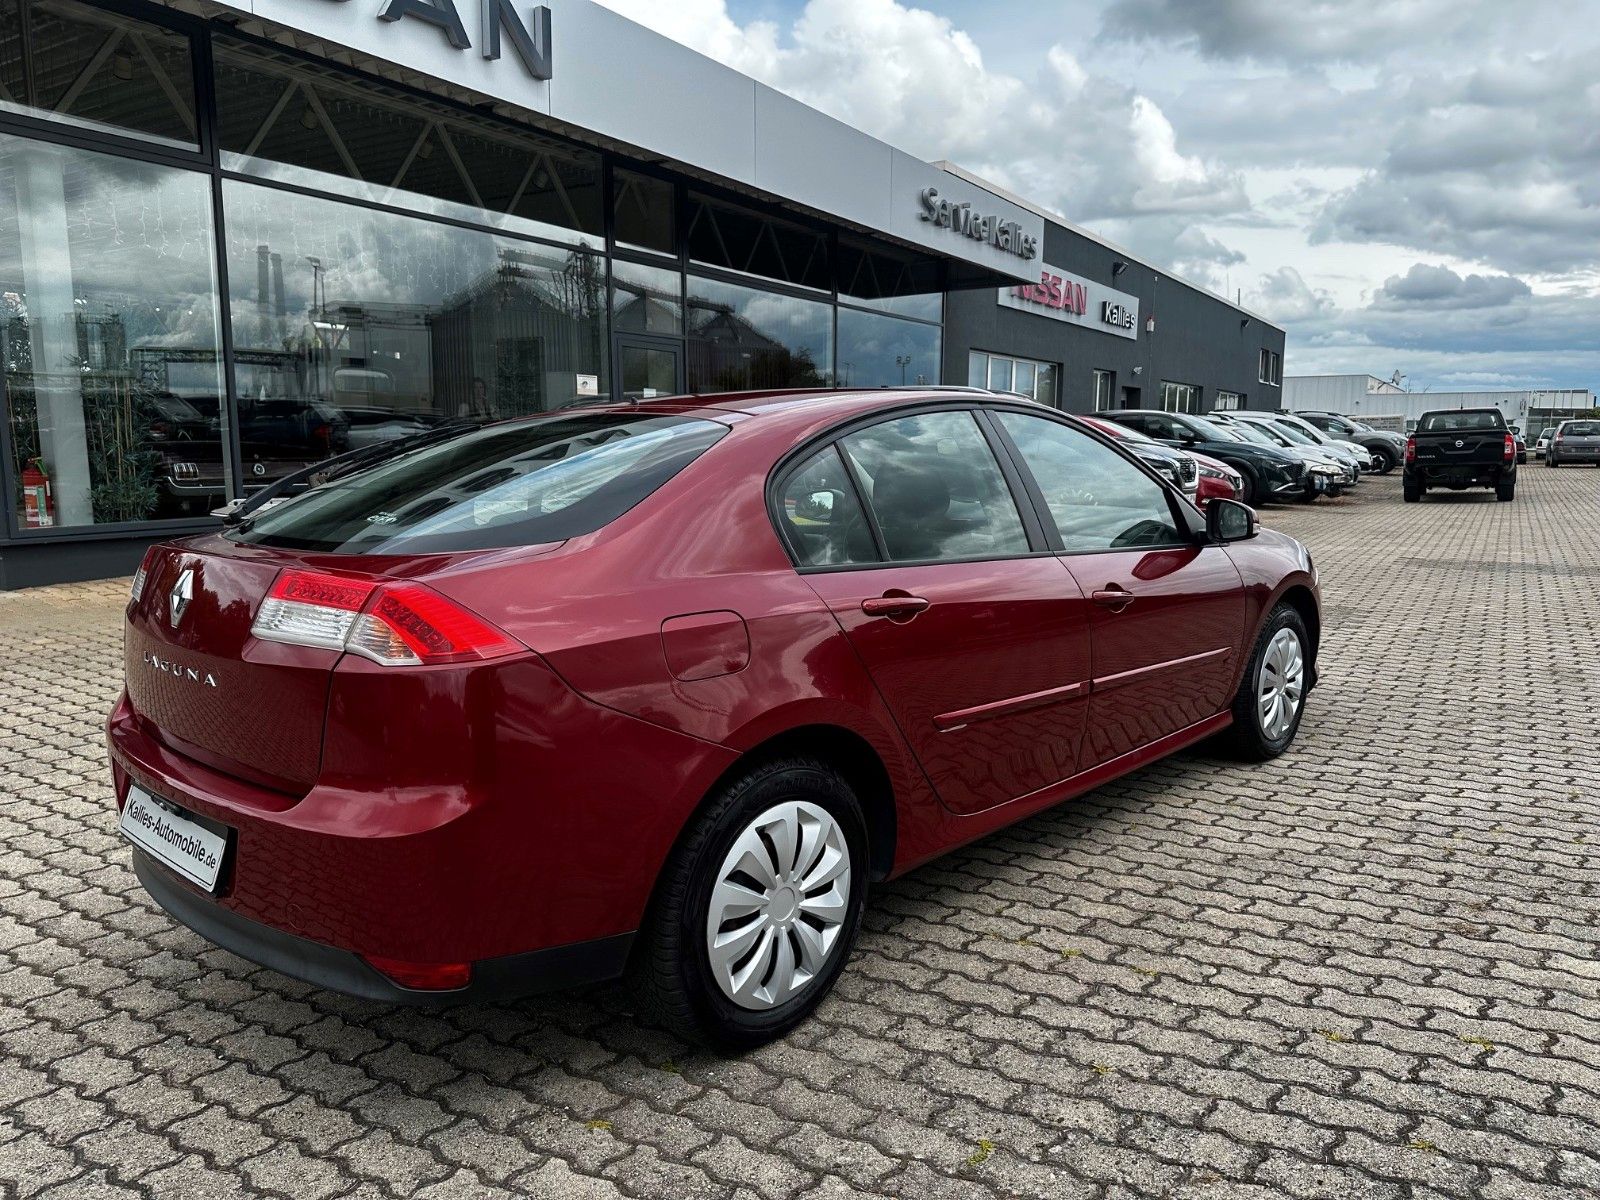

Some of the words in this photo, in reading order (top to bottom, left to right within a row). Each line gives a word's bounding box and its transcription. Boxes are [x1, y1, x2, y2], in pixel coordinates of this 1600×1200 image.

[330, 0, 552, 80] AN
[919, 187, 990, 242] Service
[989, 215, 1038, 260] Kallies
[1102, 301, 1136, 330] Kallies
[144, 650, 217, 688] LAGUNA
[127, 798, 217, 869] Kallies-Automobile.de
